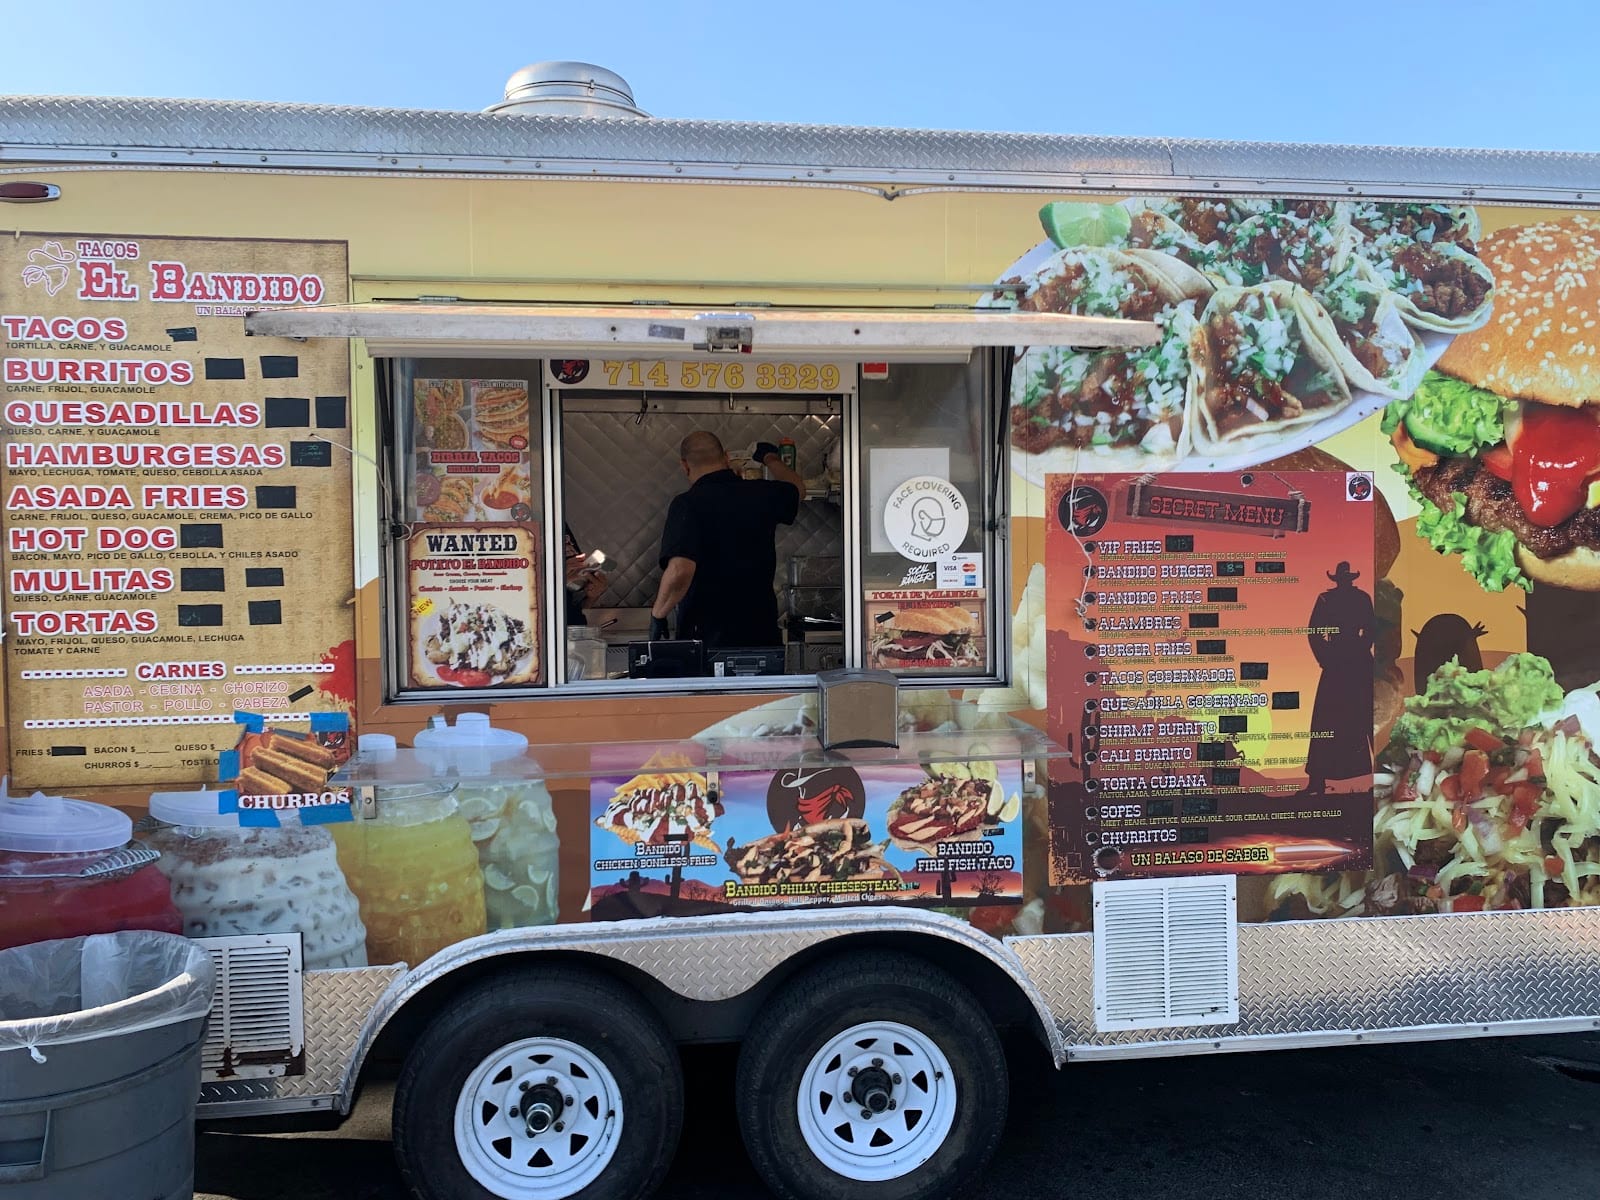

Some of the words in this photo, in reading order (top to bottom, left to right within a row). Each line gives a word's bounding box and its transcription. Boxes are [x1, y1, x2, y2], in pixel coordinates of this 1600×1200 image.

[77, 241, 139, 259] TACOS
[196, 306, 211, 315] UN
[3, 317, 127, 341] TACOS
[6, 342, 56, 351] TORTILLA,
[59, 343, 97, 352] CARNE,
[109, 344, 172, 352] GUACAMOLE
[6, 359, 193, 384] BURRITOS
[603, 360, 669, 387] 714
[680, 361, 745, 388] 576
[756, 363, 841, 391] 3329
[7, 385, 44, 393] CARNE,
[48, 385, 87, 393] FRIJOL,
[7, 402, 260, 426] QUESADILLAS
[7, 428, 45, 436] QUESO,
[49, 428, 86, 436] CARNE,
[97, 428, 160, 436] GUACAMOLE
[7, 444, 285, 467] HAMBURGESAS
[9, 469, 40, 477] MAYO,
[43, 469, 93, 477] LECHUGA,
[97, 469, 139, 477] TOMATE,
[142, 469, 179, 477] QUESO,
[182, 469, 229, 477] CEBOLLA
[9, 486, 133, 509] ASADA
[144, 486, 247, 508] FRIES
[892, 485, 914, 510] FACE
[915, 481, 962, 511] COVERING
[10, 513, 47, 521] CARNE,
[50, 513, 88, 521] FRIJOL,
[91, 513, 129, 521] QUESO,
[132, 512, 197, 520] GUACAMOLE,
[200, 512, 236, 520] CREMA,
[239, 512, 262, 520] PICO
[280, 511, 313, 519] GALLO
[1151, 496, 1219, 519] SECRET
[1224, 503, 1285, 526] MENU
[11, 529, 87, 550] HOT
[99, 528, 176, 549] DOG
[426, 534, 518, 552] WANTED
[1098, 541, 1120, 554] VIP
[1124, 540, 1162, 554] FRIES
[12, 553, 50, 561] BACON,
[53, 553, 84, 561] MAYO,
[129, 552, 166, 560] GALLO,
[902, 541, 950, 558] REQUIRED
[1098, 565, 1157, 579] BANDIDO
[1161, 564, 1214, 578] BURGER
[12, 569, 174, 592] MULITAS
[54, 594, 92, 602] CARNE,
[94, 593, 158, 601] GUACAMOLE
[1098, 591, 1157, 605] BANDIDO
[1161, 590, 1202, 604] FRIES
[413, 598, 433, 616] NEW
[12, 611, 157, 633] TORTAS
[1099, 616, 1181, 630] ALAMBRES
[16, 638, 48, 646] MAYO,
[50, 637, 88, 645] FRIJOL,
[91, 637, 129, 645] QUESO,
[131, 636, 196, 644] GUACAMOLE,
[15, 648, 54, 656] TOMATE
[56, 647, 63, 655] Y
[66, 647, 101, 655] CARNE
[1099, 643, 1151, 657] BURGER
[1154, 642, 1192, 656] FRIES
[137, 663, 225, 679] CARNES
[1099, 671, 1143, 685] TACOS
[1147, 668, 1236, 684] GOBERNADOR
[84, 686, 133, 698] ASADA
[149, 684, 204, 696] CECINA
[224, 682, 289, 694] CHORIZO
[85, 701, 144, 713] PASTOR
[164, 699, 212, 711] POLLO
[233, 697, 290, 709] CABEZA
[1100, 696, 1184, 711] QUESADILLA
[1187, 694, 1268, 709] GOBERNADO
[1158, 722, 1217, 737] BURRITO
[15, 748, 43, 756] FRIES
[94, 746, 128, 754] BACON
[175, 743, 208, 751] QUESO
[1100, 749, 1130, 763] CALI
[1134, 747, 1192, 761] BURRITO
[85, 761, 131, 769] CHURROS
[1100, 777, 1147, 791] TORTA
[1150, 774, 1207, 789] CUBANA
[238, 791, 350, 810] CHURROS
[1100, 804, 1141, 819] SOPES
[1101, 829, 1178, 845] CHURRITOS
[636, 842, 681, 855] BANDIDO
[938, 842, 994, 856] BANDIDO
[595, 859, 638, 871] CHICKEN
[639, 857, 687, 869] BONELESS
[689, 856, 717, 867] FRIES
[917, 859, 945, 871] FIRE
[948, 858, 977, 870] FISH
[979, 857, 1013, 869] TACO
[1131, 853, 1150, 866] UN
[1154, 851, 1204, 865] BALASO
[1208, 850, 1223, 863] DE
[1225, 848, 1269, 862] SABOR
[726, 881, 778, 897] BANDIDO
[820, 879, 897, 893] CHEESESTEAK
